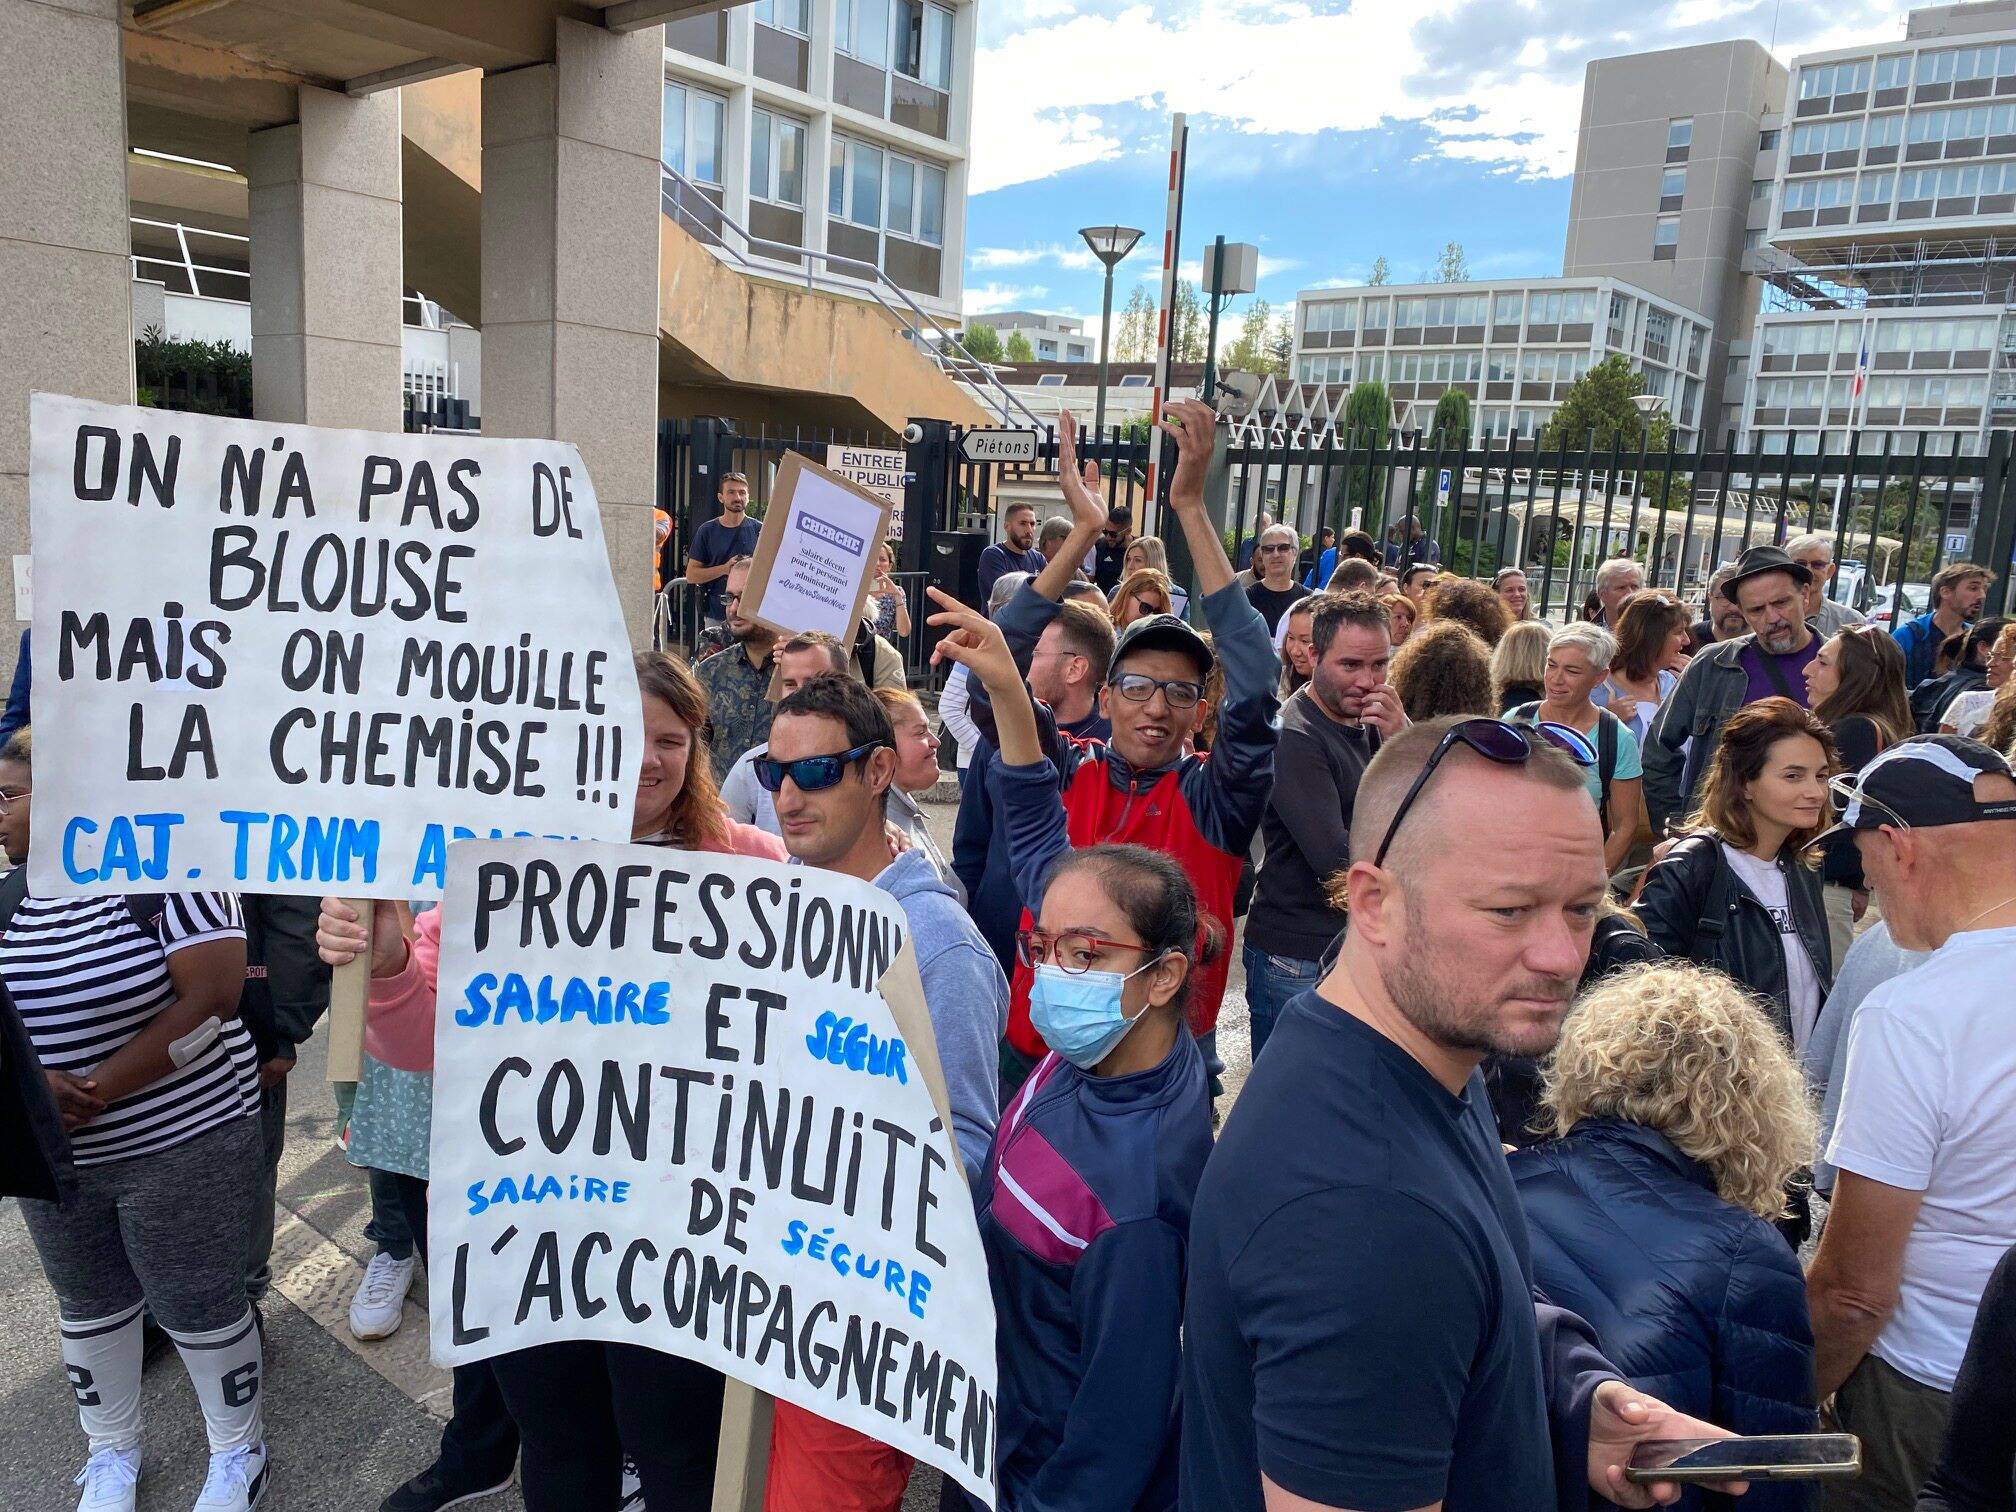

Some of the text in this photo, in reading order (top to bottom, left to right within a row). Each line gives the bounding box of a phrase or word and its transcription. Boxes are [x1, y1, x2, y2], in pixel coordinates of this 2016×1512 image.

[841, 452, 903, 470] ENTREE
[975, 438, 1030, 455] Piétons
[74, 425, 583, 539] ON N'A PAS DE
[1442, 474, 1448, 488] P
[801, 516, 861, 553] CHERCHE
[210, 526, 476, 623] BLOUSE
[790, 556, 848, 588] pour le personnel
[794, 571, 839, 596] administratif
[800, 547, 846, 574] salaire décent
[282, 630, 365, 694] ON
[126, 703, 220, 781] LA
[576, 722, 624, 810] !!!
[220, 810, 382, 884] TRNM
[705, 983, 787, 1066] ET
[687, 1177, 756, 1256] DE
[65, 1362, 102, 1407] 2
[220, 1361, 259, 1408] 6
